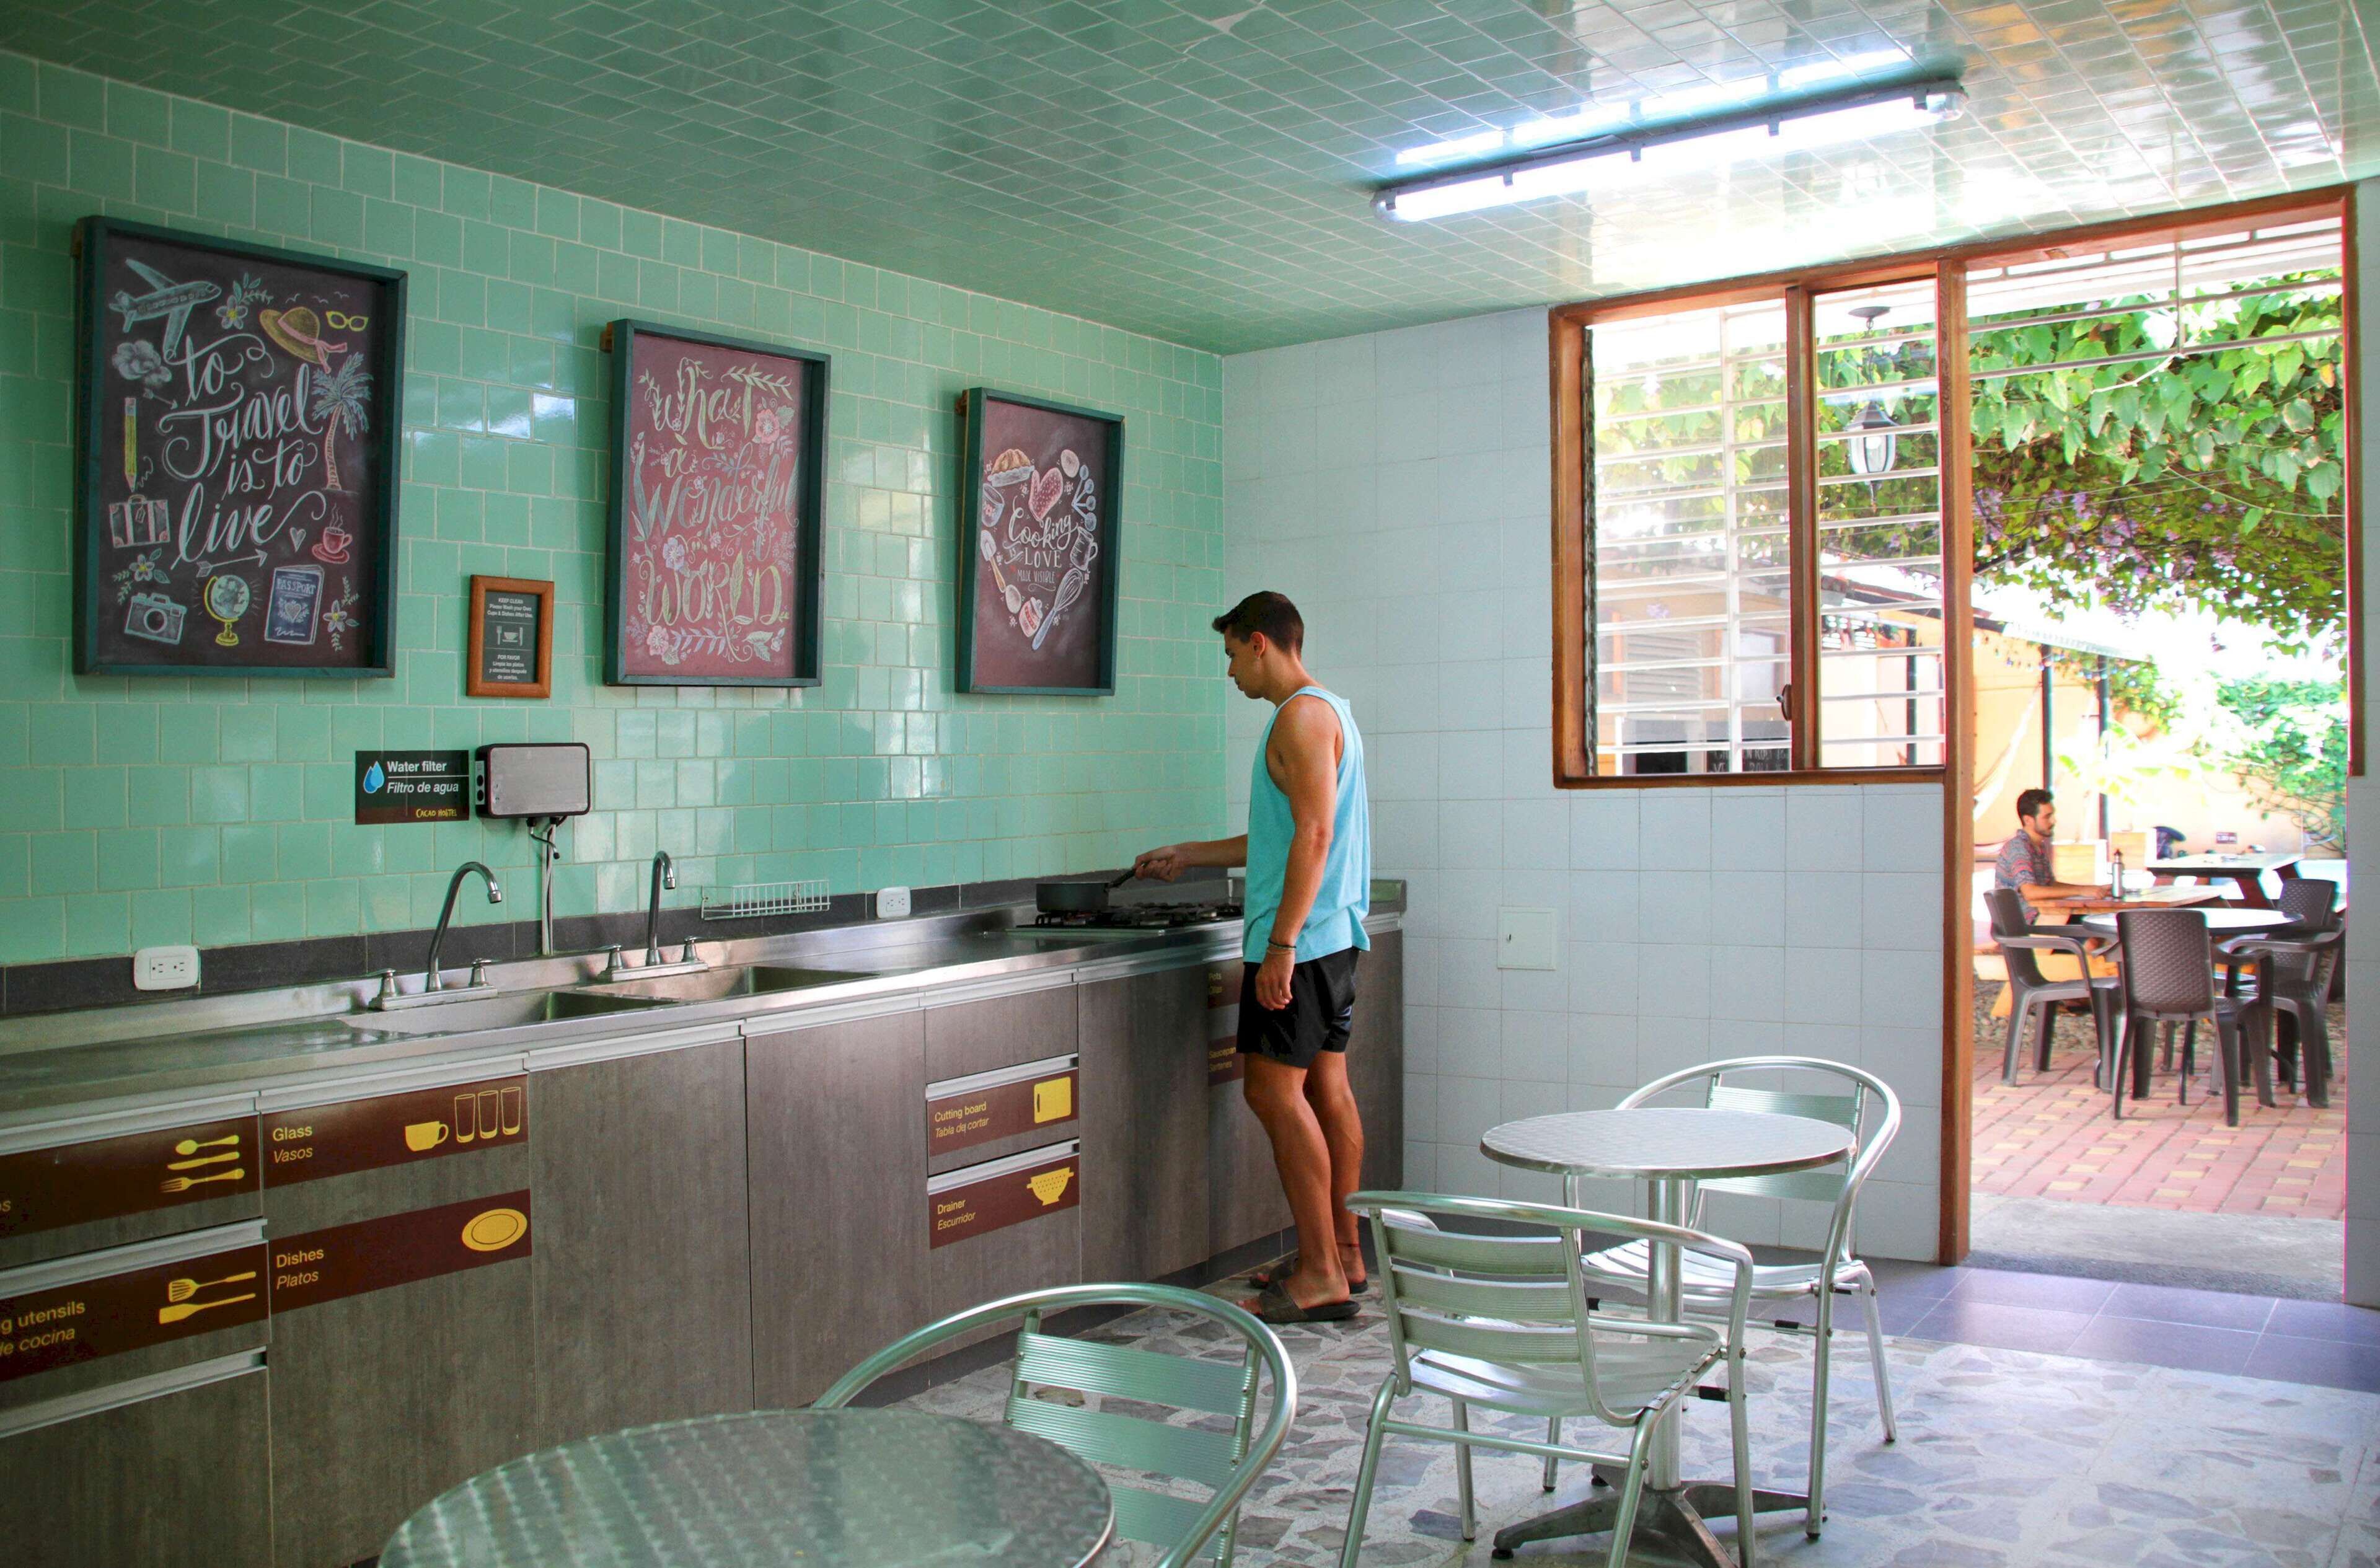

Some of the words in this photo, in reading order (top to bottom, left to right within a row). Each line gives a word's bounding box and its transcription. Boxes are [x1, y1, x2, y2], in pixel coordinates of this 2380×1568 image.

[170, 333, 267, 407] to
[158, 363, 324, 481] Travel
[223, 452, 265, 501] is
[252, 439, 318, 501] to
[172, 482, 326, 570] live
[1008, 500, 1078, 550] Cooking
[1025, 547, 1062, 568] LOVE
[276, 578, 317, 595] PASSPORT
[1017, 570, 1031, 583] MADE
[1033, 570, 1055, 584] VISIBLE
[387, 760, 420, 773] Water
[421, 760, 447, 772] filter
[387, 782, 415, 794] Filtro
[416, 782, 432, 793] de
[433, 783, 459, 795] agua
[935, 1108, 963, 1122] Cutting
[964, 1101, 987, 1116] board
[272, 1124, 313, 1142] Glass
[935, 1124, 954, 1139] Tabla
[968, 1117, 990, 1129] cortar
[273, 1146, 313, 1164] Vasos
[937, 1199, 966, 1215] Drainer
[937, 1211, 976, 1231] Escurridor
[276, 1248, 324, 1268] Dishes
[276, 1270, 319, 1290] Platos
[17, 1301, 86, 1328] utensils
[0, 1340, 14, 1357] e
[19, 1328, 76, 1352] cocina
